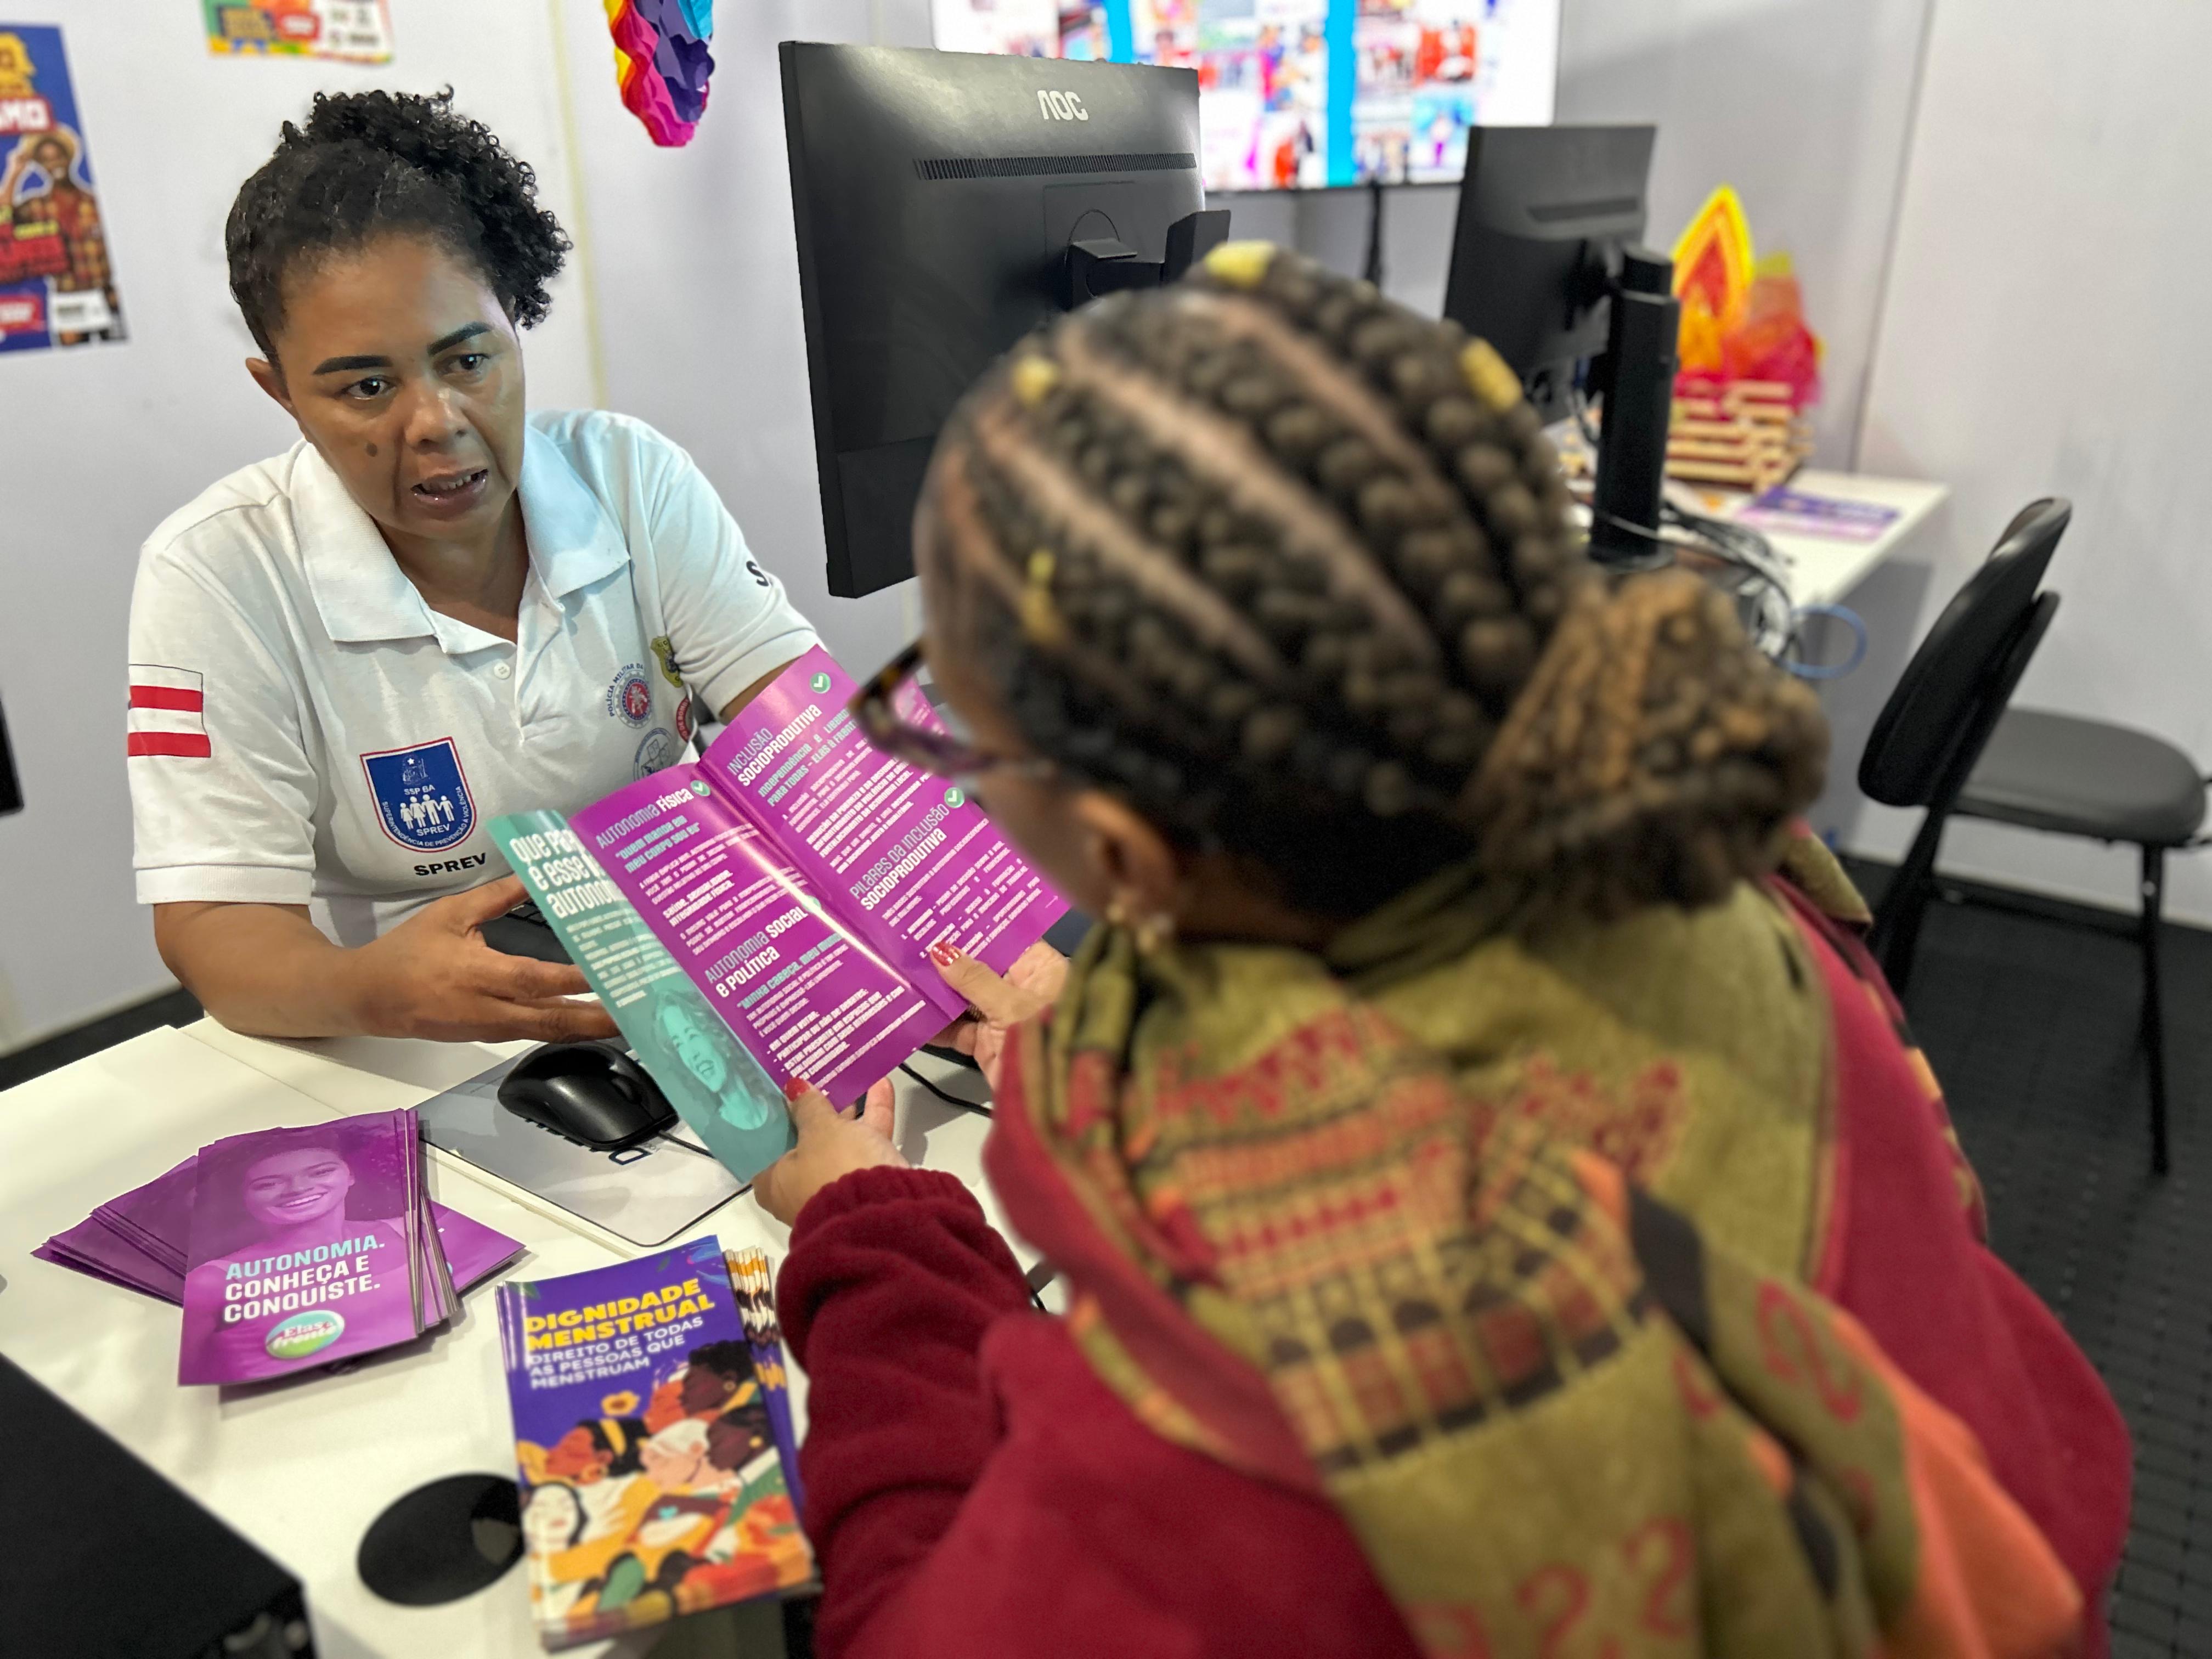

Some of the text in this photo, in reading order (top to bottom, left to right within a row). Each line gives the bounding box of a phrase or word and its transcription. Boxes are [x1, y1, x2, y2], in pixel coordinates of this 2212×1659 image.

[1037, 90, 1088, 120] AOC
[416, 823, 450, 837] SPREV
[414, 852, 486, 876] SPREV
[225, 1255, 369, 1301] CONHEÇA E
[226, 1234, 385, 1280] AUTONOMIA.
[224, 1274, 380, 1322] CONQUISTE.
[526, 1278, 701, 1333] DIGNIDADE
[527, 1294, 715, 1351] MENSTRUAL
[529, 1317, 703, 1365] DIREITO DE TODAS
[530, 1335, 685, 1379] AS PESSOAS QUE
[531, 1357, 651, 1390] MENSTRUAM
